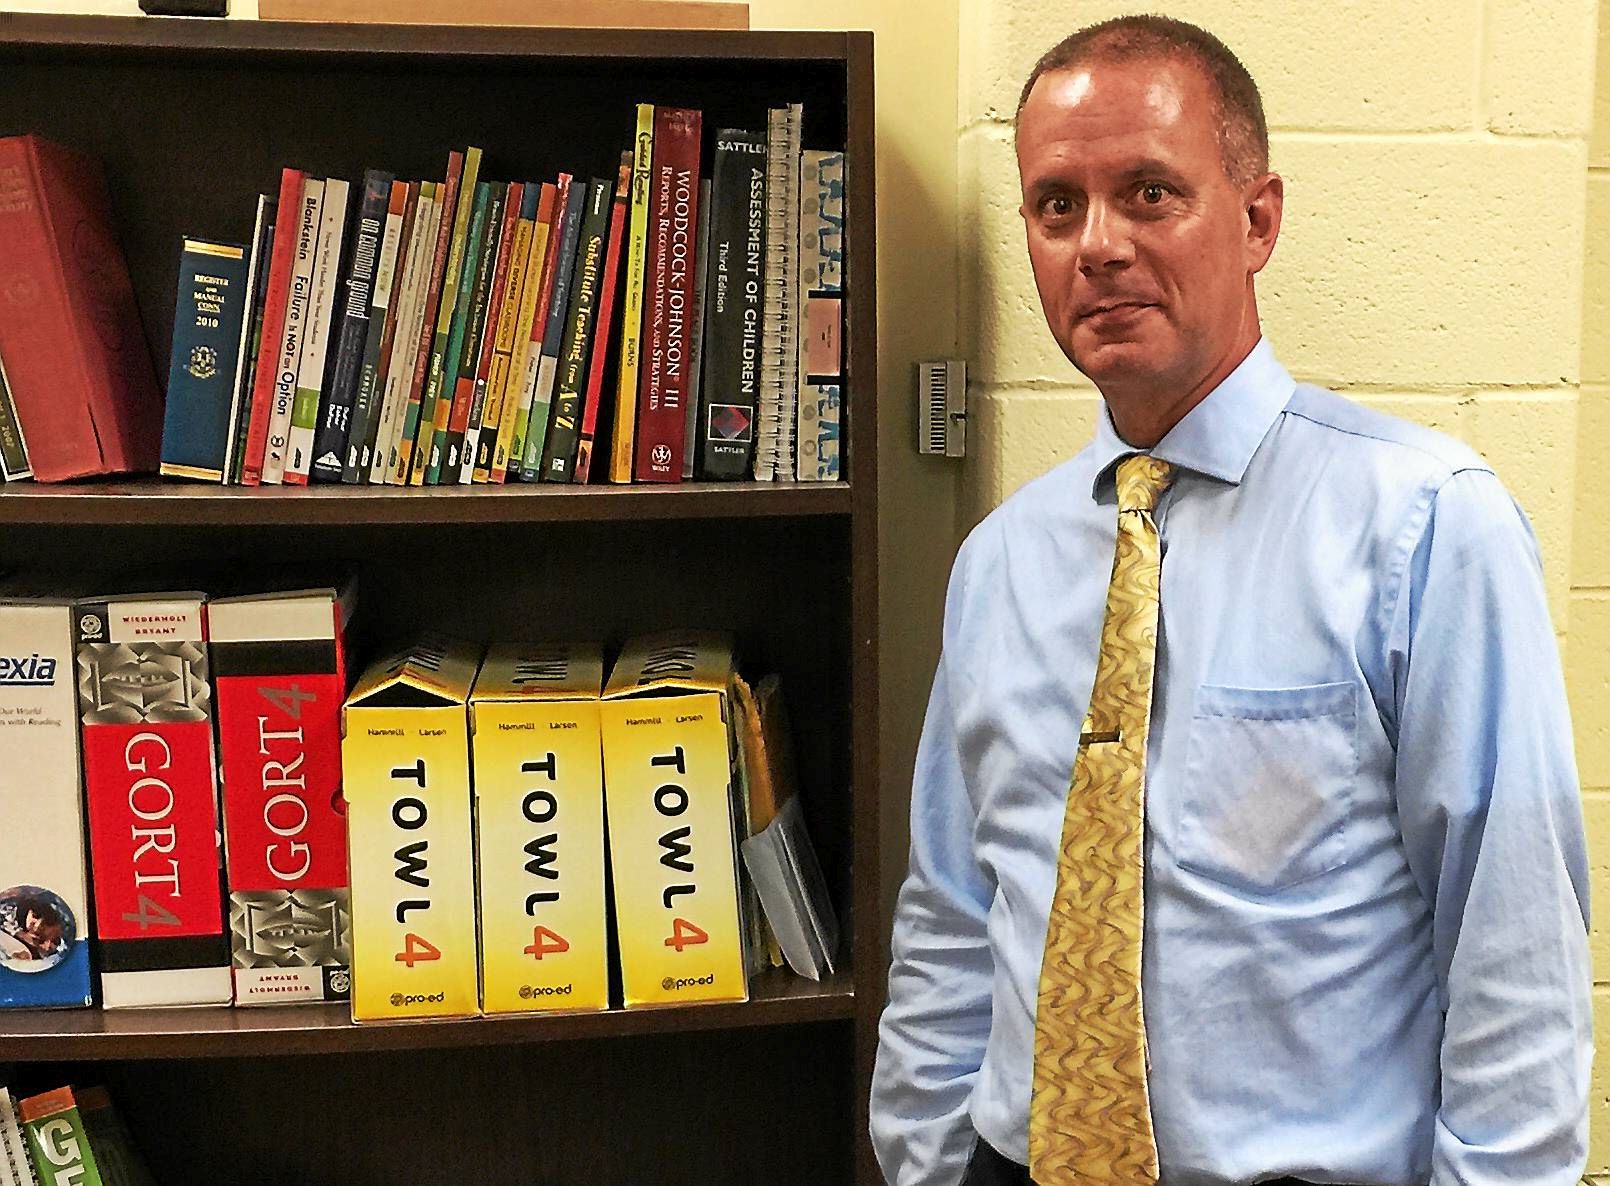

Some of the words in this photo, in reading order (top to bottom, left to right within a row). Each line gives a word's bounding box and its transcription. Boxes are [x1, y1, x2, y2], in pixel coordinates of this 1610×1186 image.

[298, 197, 316, 260] Blankstein
[360, 217, 380, 233] on
[745, 167, 764, 276] ASSESSMENT
[352, 233, 377, 279] common
[579, 234, 601, 302] Substitute
[717, 241, 729, 271] Third
[289, 274, 309, 321] Failure
[341, 279, 374, 319] ground
[715, 274, 727, 312] Edition
[744, 280, 757, 303] OF
[196, 316, 219, 328] 2010
[567, 304, 591, 362] Teaching
[284, 333, 296, 357] NOT
[739, 308, 757, 392] CHILDREN
[273, 370, 295, 416] Option
[554, 415, 574, 430] Z
